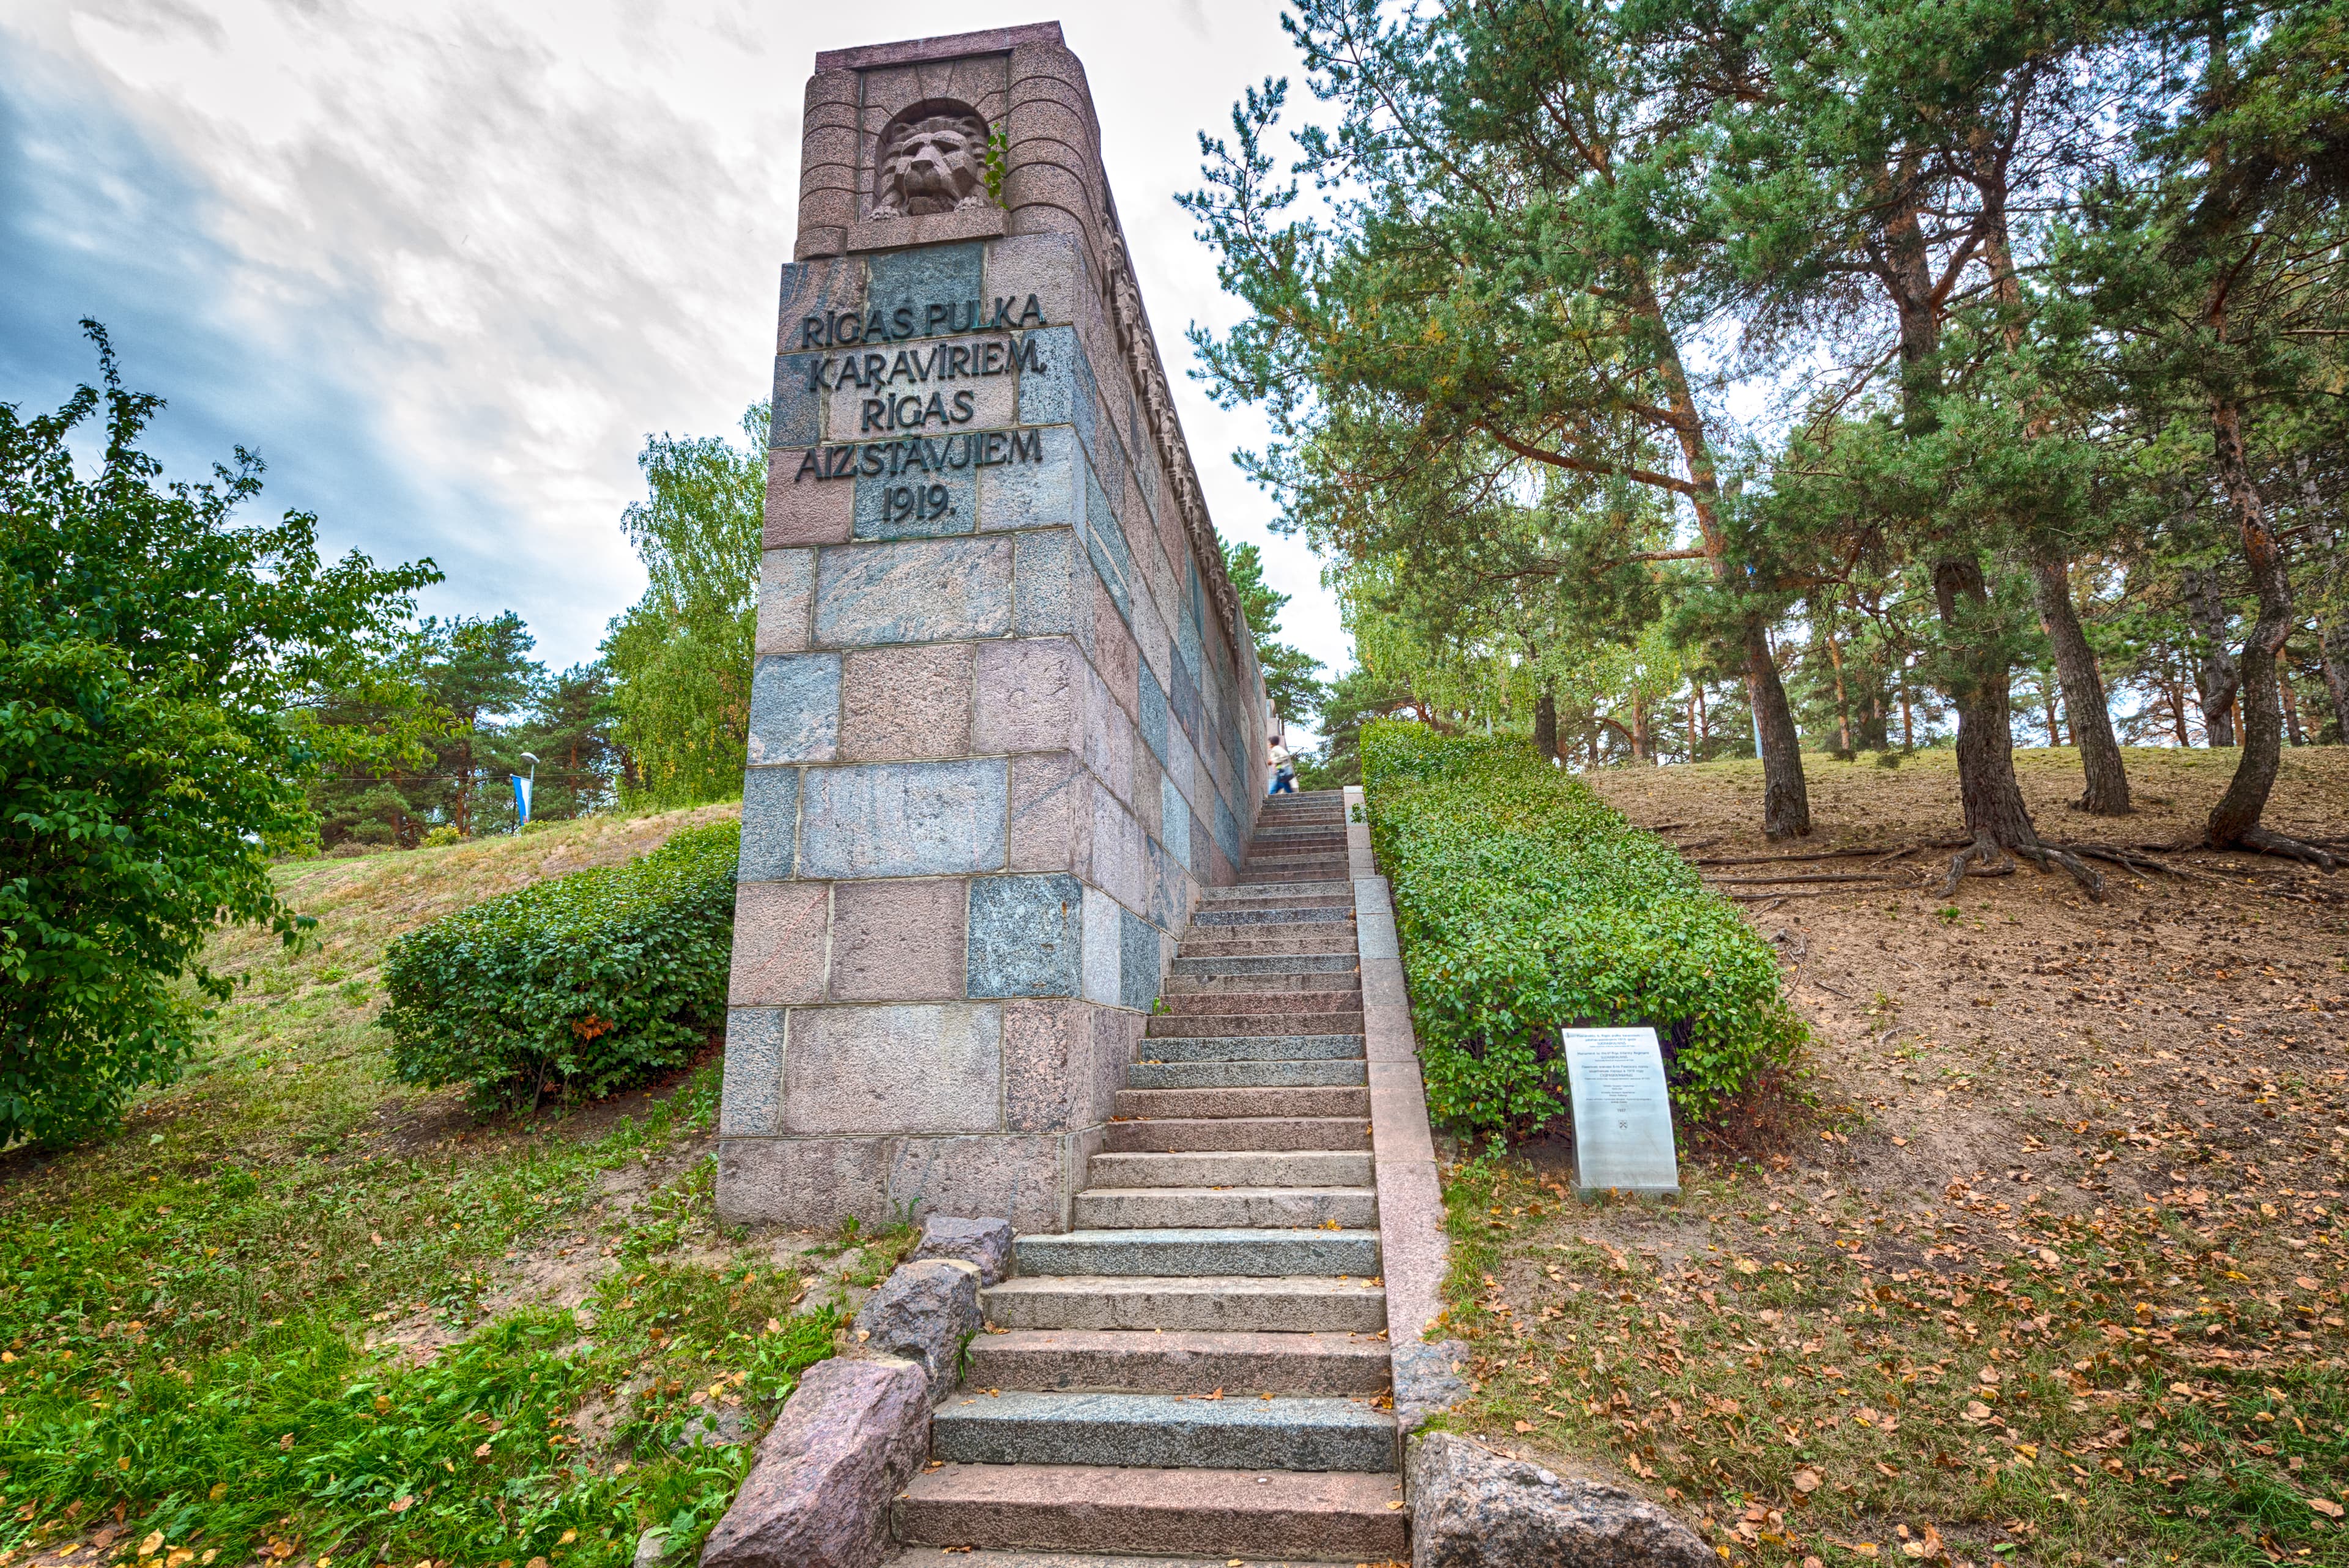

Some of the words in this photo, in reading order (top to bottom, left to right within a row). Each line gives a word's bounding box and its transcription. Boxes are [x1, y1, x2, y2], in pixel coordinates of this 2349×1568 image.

[801, 308, 914, 348] RĪGAS
[924, 293, 1047, 335] PULKA
[861, 390, 974, 431] RĪGAS
[883, 483, 956, 522] 1919.
